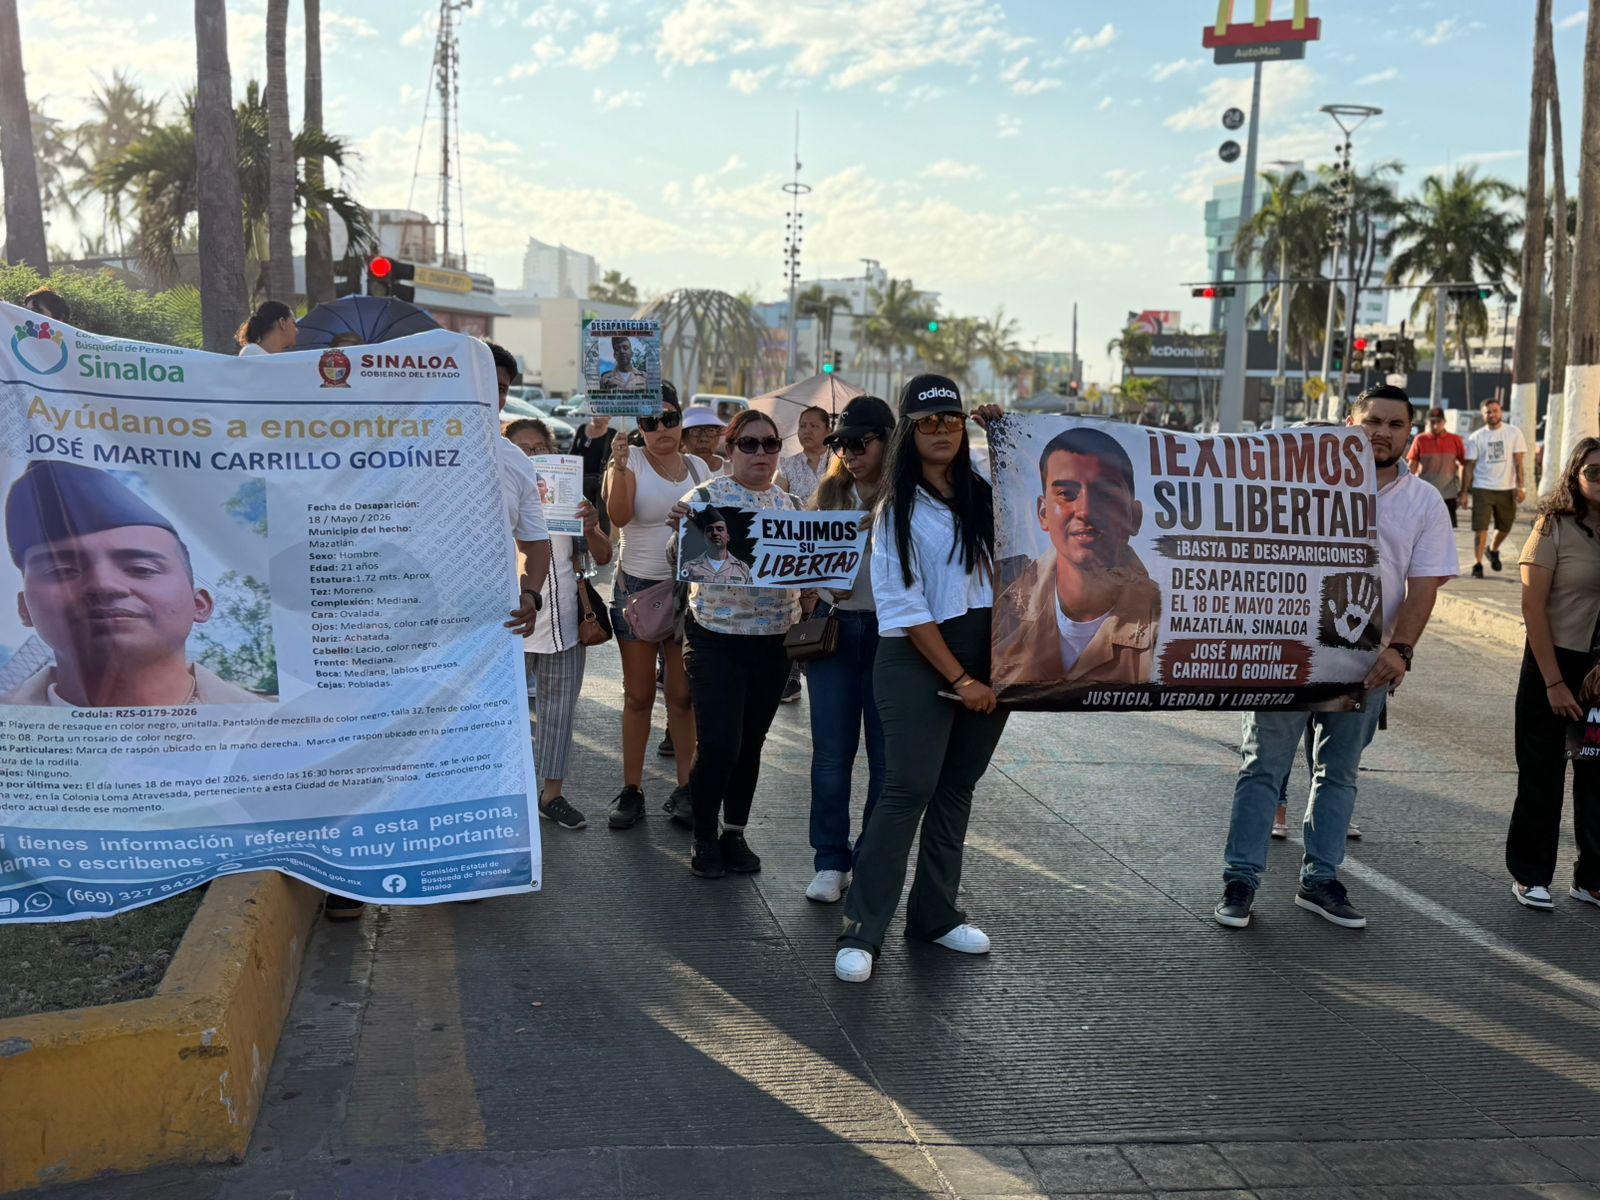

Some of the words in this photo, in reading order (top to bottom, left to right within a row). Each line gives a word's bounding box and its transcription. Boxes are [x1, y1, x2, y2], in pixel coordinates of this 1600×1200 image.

[75, 340, 123, 352] Búsqueda
[125, 342, 137, 352] de
[138, 342, 184, 355] Personas
[79, 354, 185, 383] Sinaloa
[361, 354, 458, 369] SINALOA
[361, 370, 406, 378] GOBIERNO
[918, 387, 957, 401] adidas
[26, 395, 212, 438] Ayúdanos
[226, 417, 247, 438] a
[261, 415, 433, 439] encontrar
[446, 418, 464, 437] a
[26, 434, 84, 459] JOSÉ
[93, 443, 201, 469] MARTIN
[211, 451, 341, 471] CARRILLO
[349, 446, 461, 469] GODÍNEZ
[1147, 430, 1365, 487] ¡EXIGIMOS
[308, 503, 336, 512] Fecha
[339, 503, 351, 511] de
[354, 500, 420, 512] Desaparición:
[1153, 480, 1202, 530] SU
[1213, 483, 1377, 540] LIBERTAD!
[309, 516, 321, 524] 18
[331, 515, 358, 525] Mayo
[368, 513, 391, 522] 2026
[308, 526, 358, 537] Municipio
[361, 526, 376, 534] del
[379, 525, 412, 533] hecho:
[762, 518, 857, 541] EXIJIMOS
[309, 538, 357, 548] Mazatlán.
[799, 542, 815, 553] SU
[309, 552, 337, 560] Sexo:
[1177, 540, 1227, 558] ¡BASTA
[1231, 543, 1249, 559] DE
[1253, 543, 1367, 564] DESAPARICIONES!
[309, 564, 338, 572] Edad:
[341, 563, 353, 571] 21
[757, 551, 859, 579] LIBERTAD
[403, 572, 433, 581] Aprox.
[1171, 567, 1307, 594] DESAPARECIDO
[310, 588, 331, 596] Tez:
[333, 586, 376, 595] Moreno.
[311, 597, 374, 608] Complexión:
[376, 596, 422, 605] Mediana.
[1170, 595, 1188, 612] EL
[1193, 595, 1207, 613] 18
[1212, 596, 1229, 614] DE
[1234, 597, 1273, 615] MAYO
[1278, 598, 1311, 616] 2026
[311, 611, 338, 619] Cara:
[340, 610, 382, 618] Ovalada.
[311, 623, 338, 632] Ojos:
[340, 622, 391, 630] Medianos,
[394, 620, 417, 628] color
[420, 618, 439, 626] café
[1170, 615, 1247, 635] MAZATLÁN,
[1251, 618, 1308, 635] SINALOA
[312, 635, 341, 643] Nariz:
[312, 647, 353, 655] Cabello:
[355, 645, 384, 654] Lacio,
[385, 643, 409, 652] color
[411, 642, 440, 651] negro.
[1190, 641, 1226, 660] JOSÉ
[1230, 641, 1282, 660] MARTÍN
[314, 659, 348, 667] Frente:
[351, 657, 396, 666] Mediana.
[315, 670, 342, 678] Boca:
[344, 669, 389, 678] Mediana,
[391, 666, 419, 675] labios
[1172, 662, 1238, 680] CARRILLO
[1241, 659, 1298, 680] GODÍNEZ
[317, 681, 346, 690] Cejas:
[347, 680, 393, 689] Pobladas.
[1083, 691, 1154, 707] JUSTICIA,
[1159, 692, 1214, 707] VERDAD
[1220, 694, 1229, 706] Y
[1230, 692, 1295, 706] LIBERTAD
[9, 720, 45, 731] Playera
[48, 722, 60, 730] de
[62, 723, 103, 732] resaque
[105, 723, 118, 731] en
[120, 722, 144, 730] color
[223, 717, 266, 727] Pantalón
[267, 716, 279, 726] de
[323, 714, 335, 724] de
[336, 713, 358, 723] color
[426, 705, 447, 714] Tenis
[448, 704, 458, 713] de
[460, 702, 481, 712] color
[71, 709, 113, 719] Cedula:
[116, 708, 198, 718] RZS-0179-2026
[37, 734, 64, 742] Porta
[83, 734, 118, 743] rosario
[120, 734, 133, 742] de
[164, 734, 196, 742] negro.
[9, 744, 73, 754] Particulares:
[76, 746, 107, 754] Marca
[110, 746, 122, 754] de
[125, 746, 160, 755] raspón
[162, 744, 202, 754] ubicado
[204, 743, 217, 752] en
[219, 743, 227, 751] la
[230, 741, 258, 750] mano
[26, 769, 72, 779] Ninguno.
[18, 835, 89, 851] tienes
[100, 832, 234, 851] información
[245, 823, 340, 847] referente
[352, 825, 365, 837] a
[374, 818, 419, 834] esta
[429, 806, 519, 832] persona,
[58, 859, 72, 868] o
[79, 855, 211, 870] escribenos.
[322, 845, 343, 858] es
[350, 839, 396, 858] muy
[403, 826, 519, 853] importante.
[421, 867, 459, 877] Comisión
[460, 861, 488, 872] Estatal
[490, 860, 500, 868] de
[421, 874, 461, 885] Búsqueda
[475, 868, 511, 877] Personas
[422, 884, 452, 892] Sinaloa
[66, 888, 114, 906] (669)
[119, 888, 153, 901] 327
